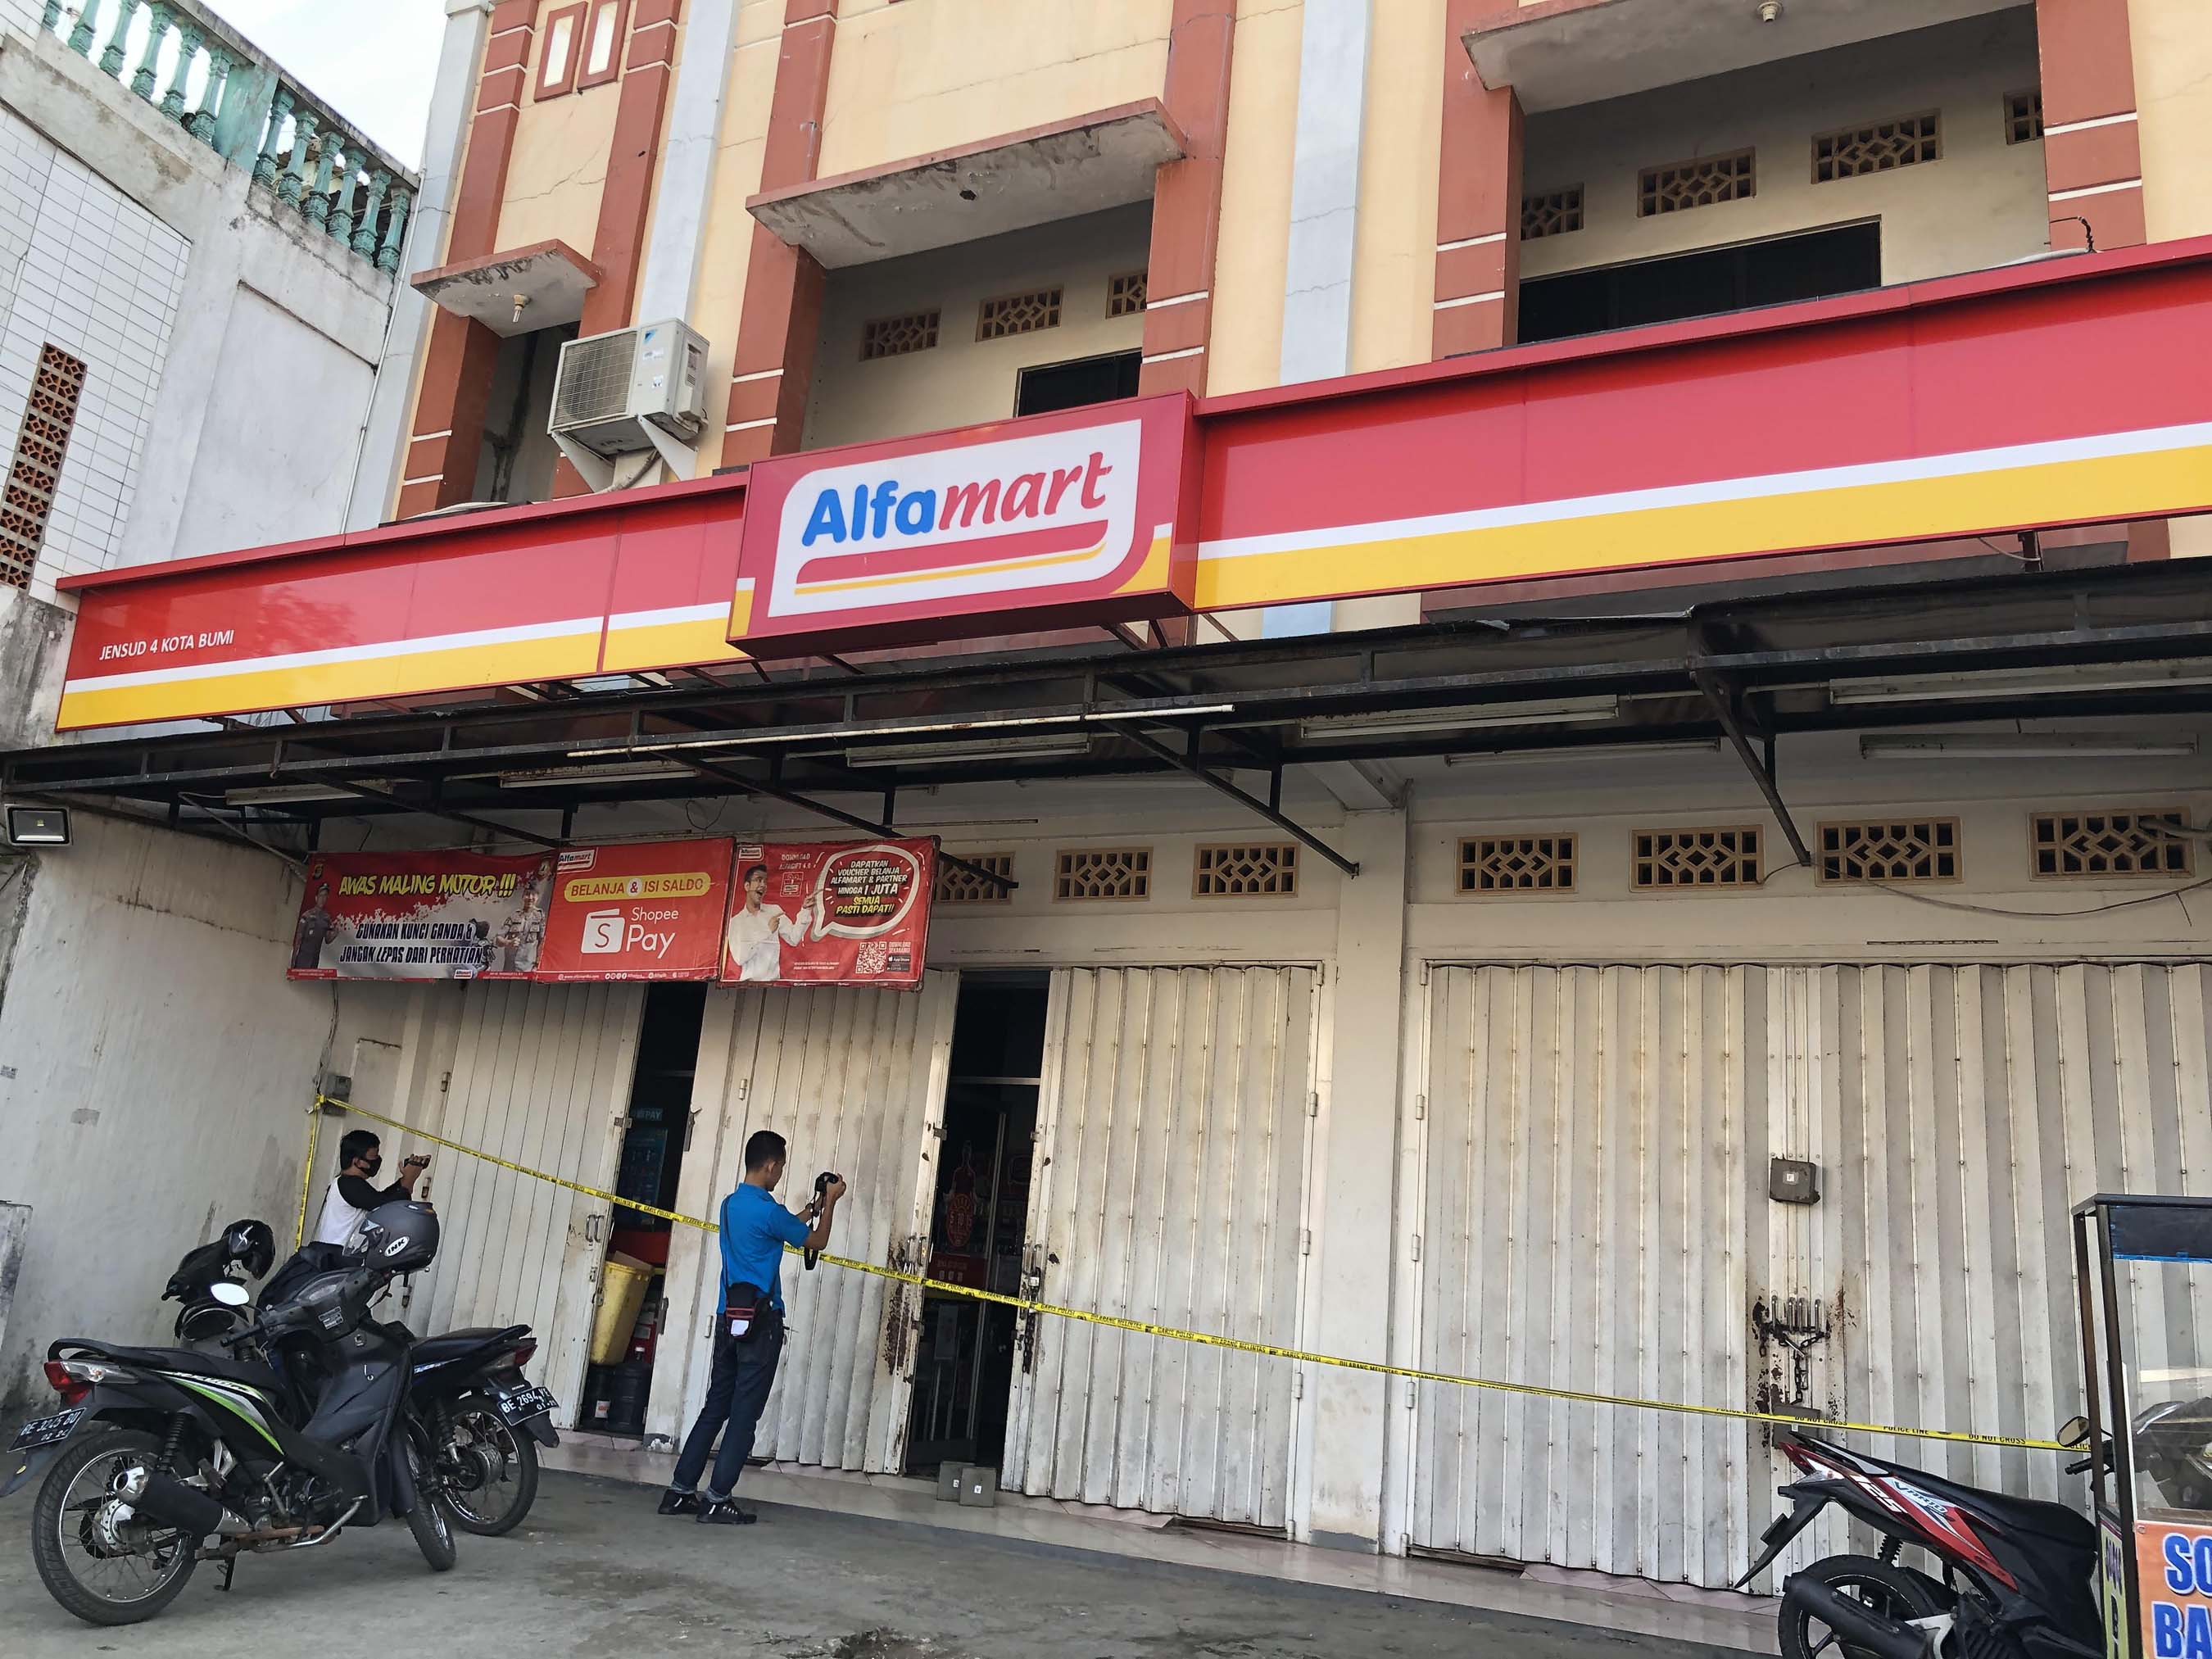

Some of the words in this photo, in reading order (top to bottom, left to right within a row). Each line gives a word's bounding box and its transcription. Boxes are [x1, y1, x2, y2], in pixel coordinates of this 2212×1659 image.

[801, 451, 1113, 546] Alfamart
[99, 641, 147, 661] JENSUD
[150, 641, 158, 653] 4
[161, 635, 194, 653] KOTA
[198, 630, 235, 648] BUMI
[871, 867, 900, 875] BELANJA
[876, 874, 908, 883] PARTNER
[339, 875, 376, 895] AWAS
[378, 874, 435, 895] MALING
[438, 874, 496, 896] MOTOR
[498, 873, 516, 897] !!!
[571, 882, 624, 896] BELANJA
[630, 882, 639, 893] &
[644, 880, 659, 891] ISI
[663, 878, 703, 891] SALDO
[838, 886, 863, 895] HINGGA
[871, 884, 899, 895] JUTA
[854, 896, 881, 905] SEMUA
[631, 907, 679, 924] Shopee
[836, 905, 859, 914] PASTI
[862, 904, 895, 913] DAPAT!!
[356, 923, 399, 940] GUNAKAN
[401, 923, 429, 940] KUNCI
[431, 923, 463, 940] GANDA
[626, 924, 676, 959] Pay
[376, 946, 405, 963] LEPAS
[406, 946, 428, 963] DARI
[429, 947, 483, 964] PERHATIAN
[388, 1238, 406, 1254] INK
[1157, 1326, 1175, 1336] GARIS
[1175, 1330, 1194, 1339] POLISI
[1211, 1337, 1238, 1348] DILARANG
[1239, 1342, 1266, 1353] MELINTAS
[1282, 1350, 1299, 1359] GARIS
[1301, 1353, 1321, 1362] POLISI
[501, 1398, 517, 1413] BE
[517, 1390, 539, 1407] 2694
